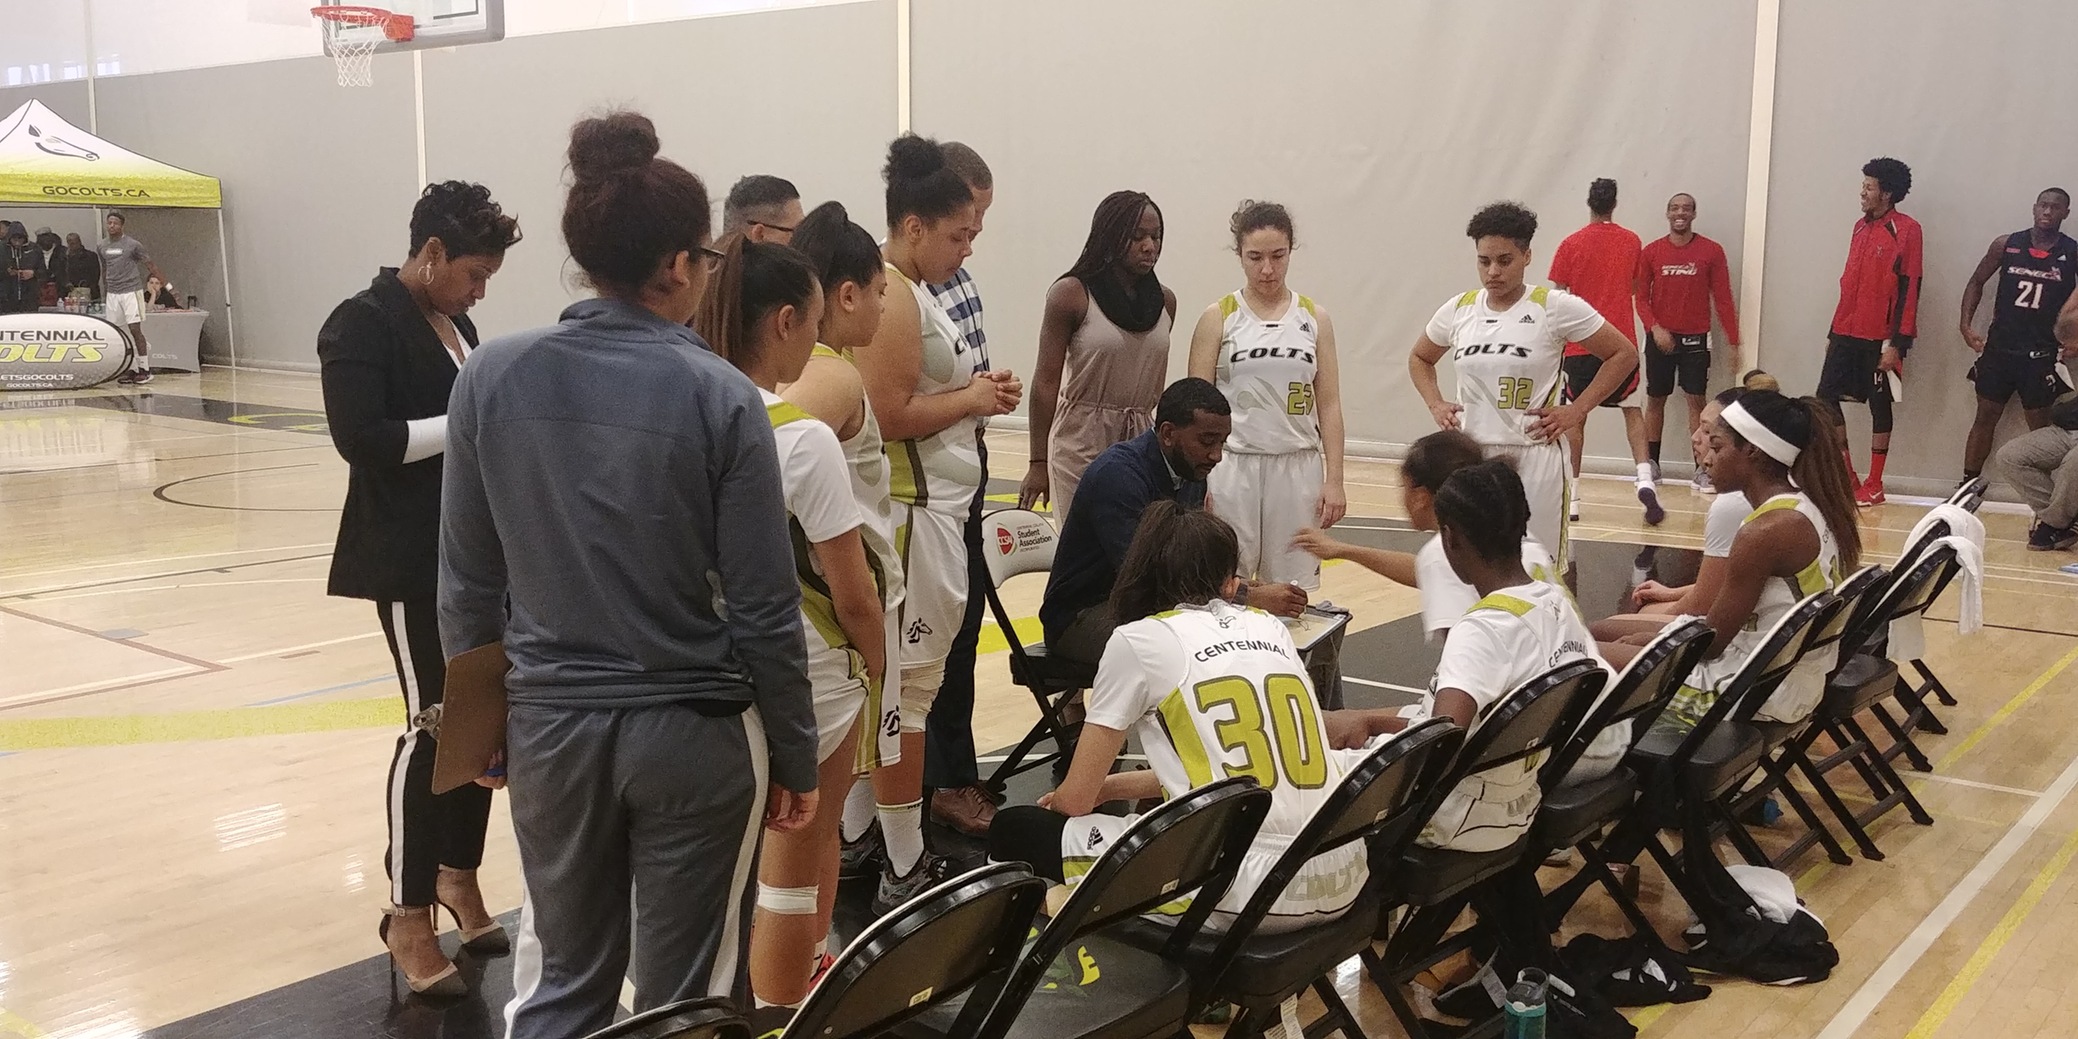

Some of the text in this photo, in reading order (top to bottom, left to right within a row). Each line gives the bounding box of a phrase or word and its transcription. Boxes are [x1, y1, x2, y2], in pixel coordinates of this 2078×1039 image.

[42, 185, 151, 198] GOCOLTS.CA
[2007, 266, 2062, 281] SENECA
[2014, 280, 2043, 309] 21
[0, 330, 105, 341] TENNIAL
[1230, 346, 1315, 364] COLTS
[1453, 343, 1532, 361] COLTS
[1497, 376, 1534, 410] 32
[1017, 528, 1041, 539] Student
[1019, 535, 1052, 547] Association
[1194, 639, 1290, 663] CENTENNIAL
[1192, 673, 1328, 792] 30
